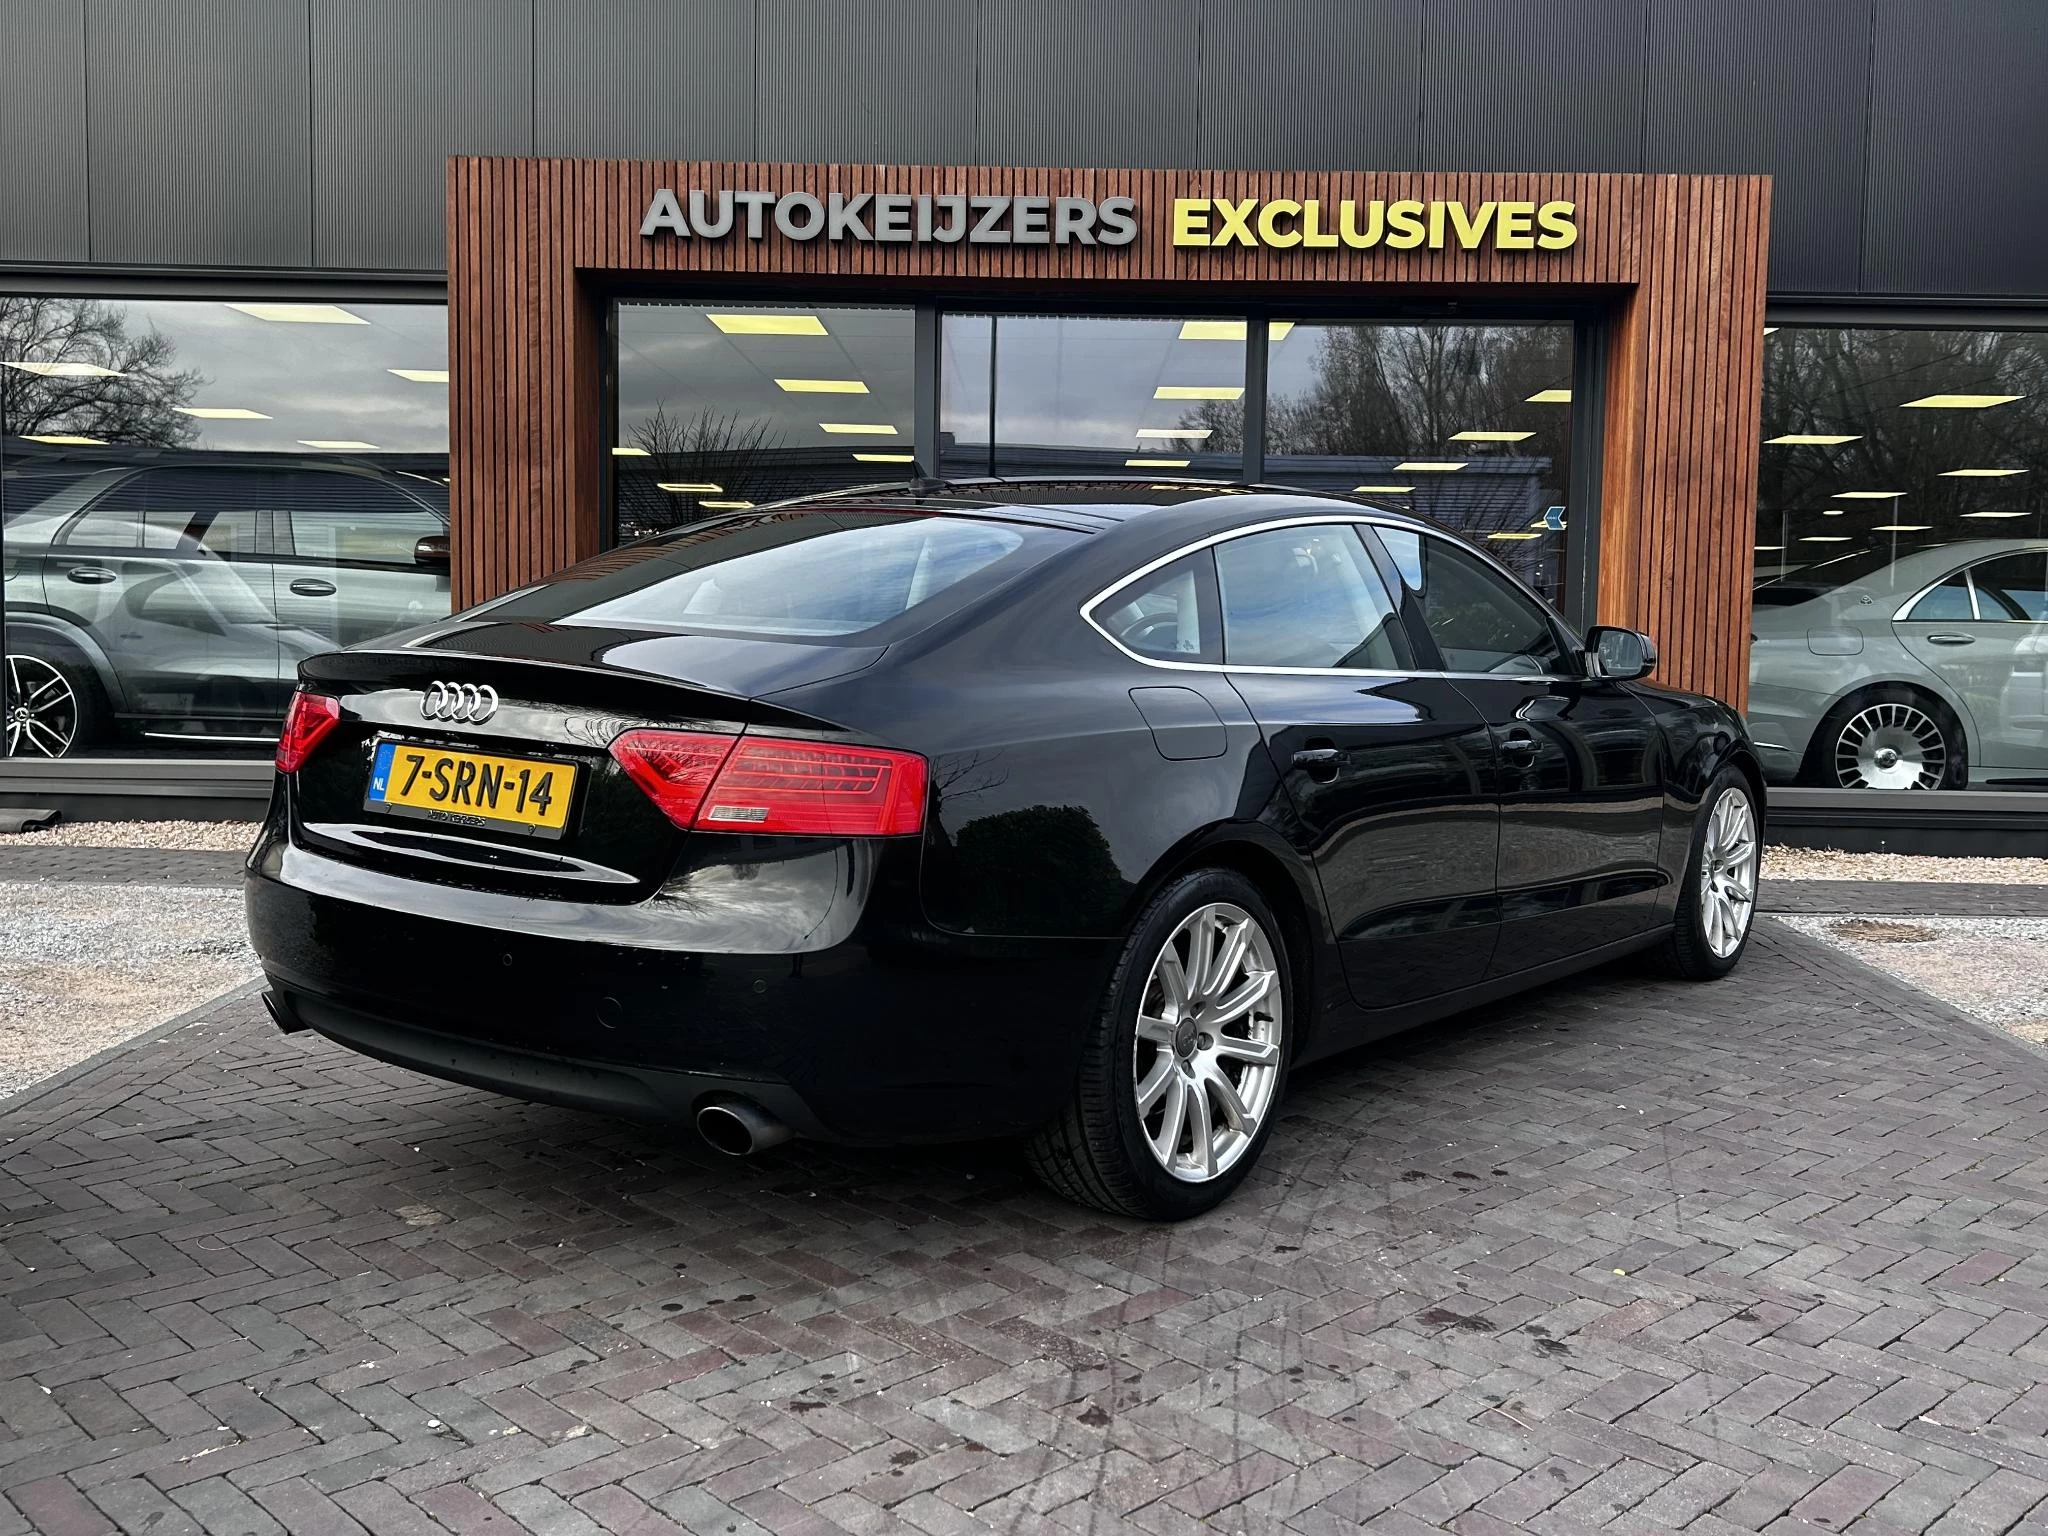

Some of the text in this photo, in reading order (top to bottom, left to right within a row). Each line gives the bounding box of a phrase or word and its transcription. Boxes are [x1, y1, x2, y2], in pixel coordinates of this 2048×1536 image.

[640, 189, 1578, 249] AUTOKEIJZERS EXCLUSIVES
[372, 776, 386, 791] NL
[400, 754, 553, 816] 7-SRN-14
